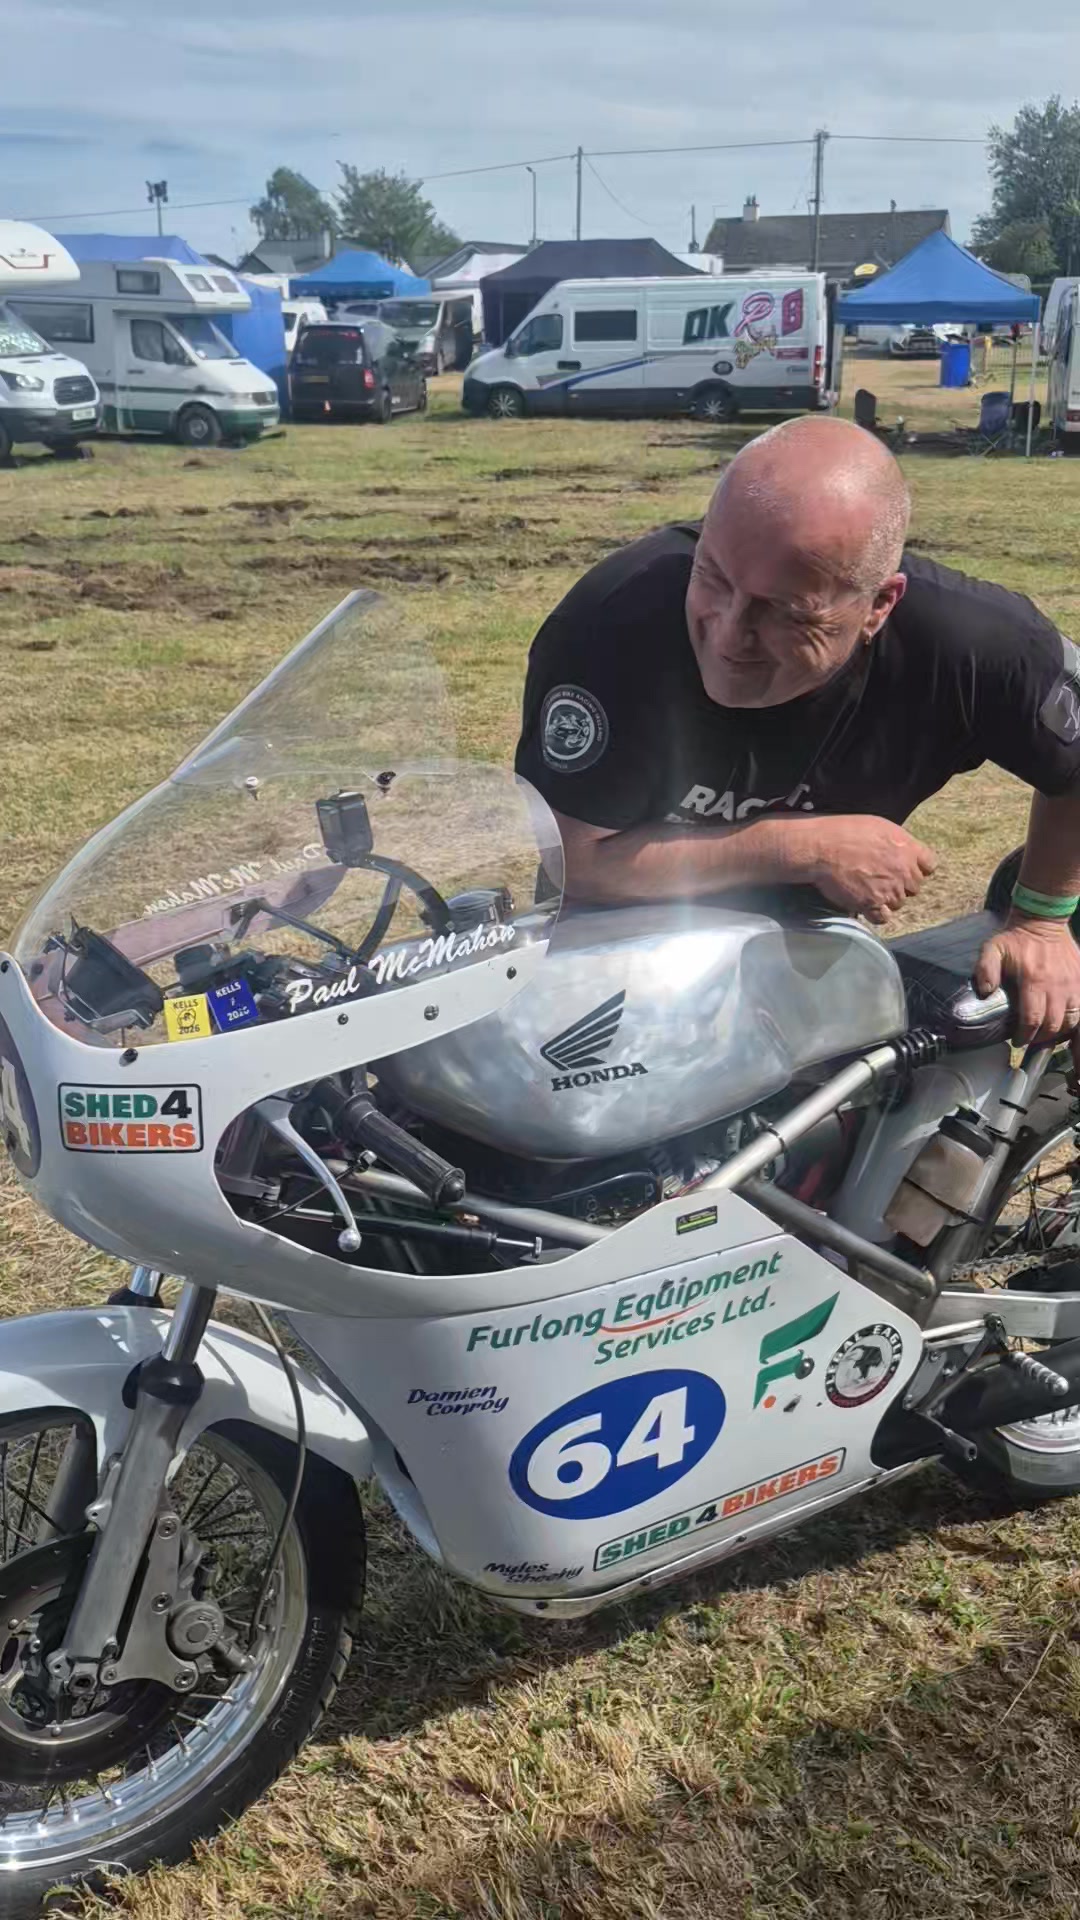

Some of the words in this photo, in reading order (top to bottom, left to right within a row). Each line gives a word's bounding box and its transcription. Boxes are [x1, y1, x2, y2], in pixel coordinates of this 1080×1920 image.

[285, 966, 360, 1013] Paul
[368, 923, 516, 984] McMahon
[172, 998, 199, 1010] KELLS
[216, 981, 242, 998] KELLS
[550, 1062, 648, 1091] HONDA
[66, 1121, 196, 1148] BIKERS
[466, 1314, 605, 1352] Furlong
[613, 1250, 783, 1323] Equipment
[594, 1310, 716, 1365] Services
[722, 1286, 776, 1324] Ltd.
[825, 1332, 862, 1385] LEGAL
[872, 1325, 902, 1361] EAGLE
[407, 1386, 498, 1404] Damien
[426, 1396, 510, 1416] Conroy
[527, 1386, 696, 1500] 64
[600, 1516, 690, 1565] SHED
[695, 1504, 718, 1525] 4
[722, 1456, 840, 1516] BIKERS
[483, 1561, 549, 1576] Myles
